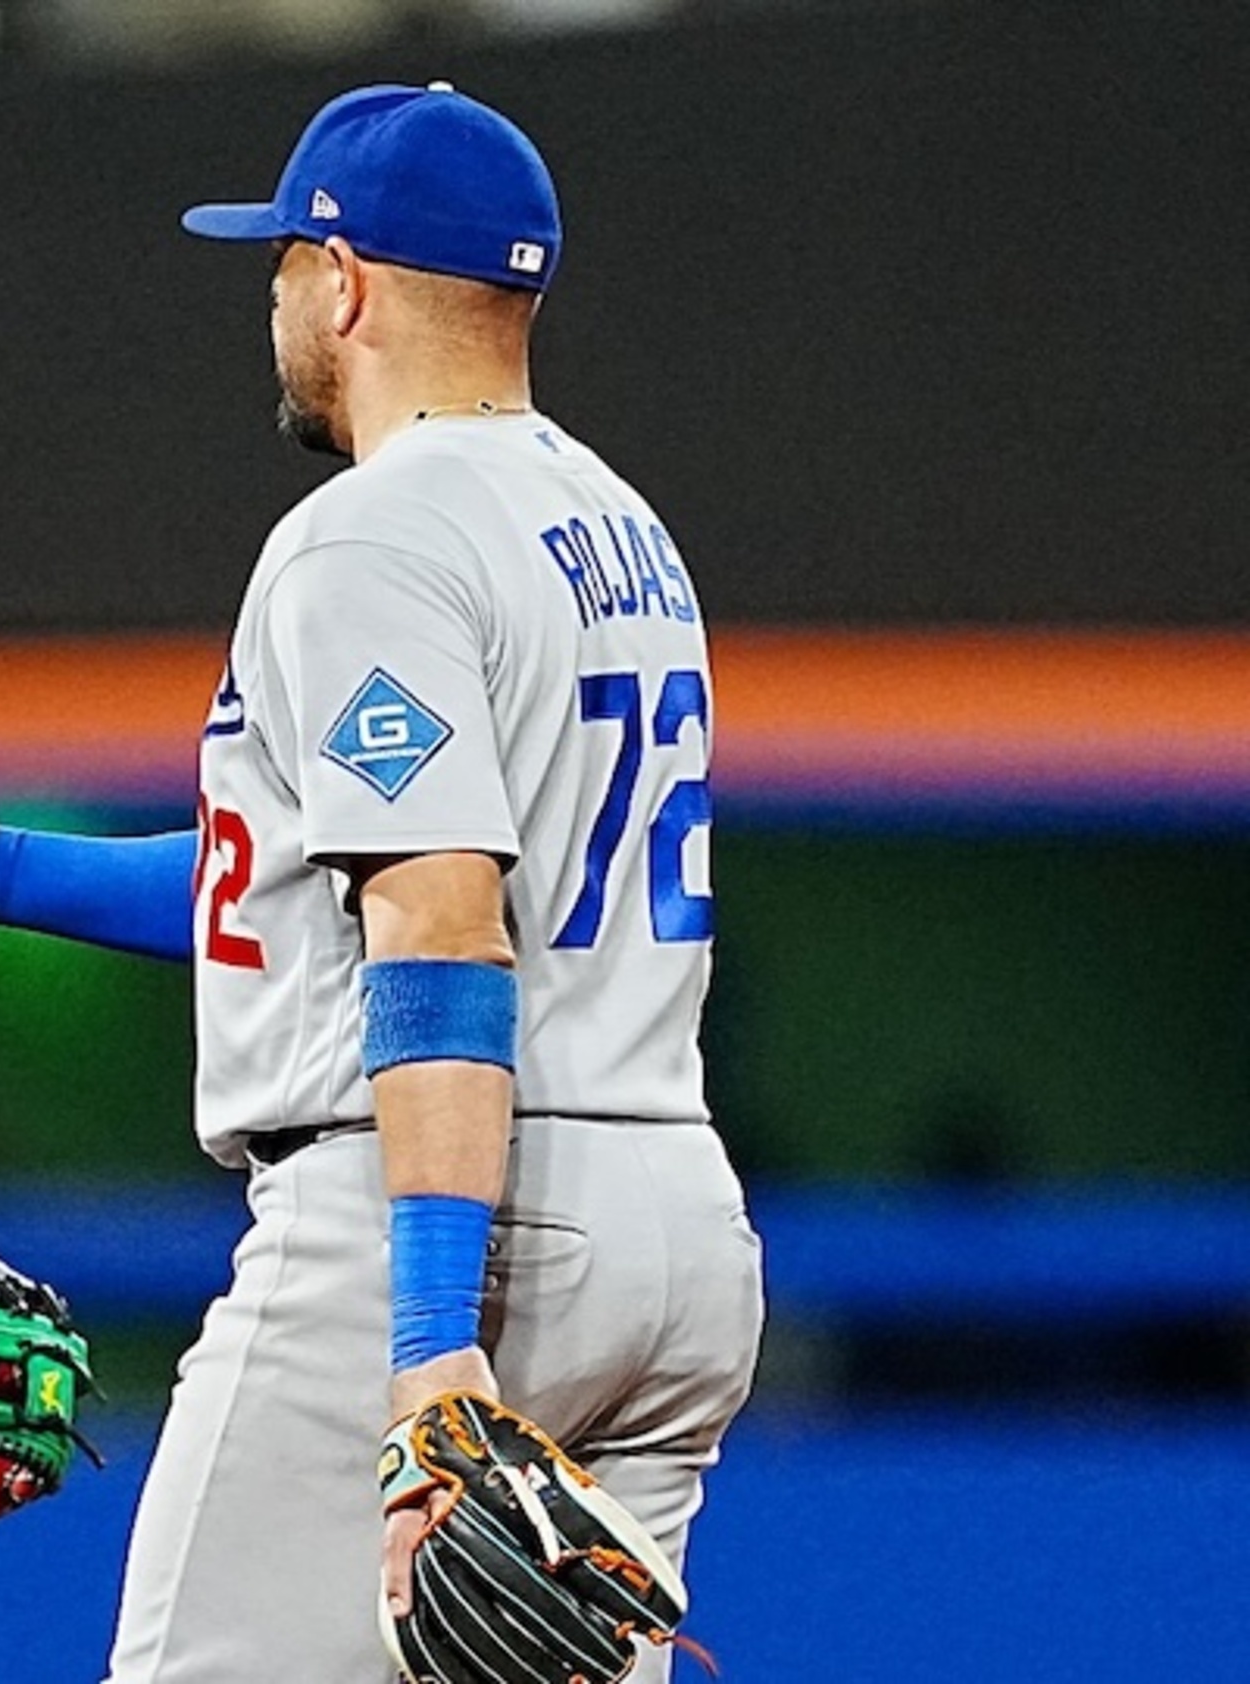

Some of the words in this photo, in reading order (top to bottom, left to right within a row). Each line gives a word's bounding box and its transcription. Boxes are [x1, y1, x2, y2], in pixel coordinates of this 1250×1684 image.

[540, 514, 695, 630] ROJAS
[358, 703, 410, 749] G
[549, 667, 713, 949] 72
